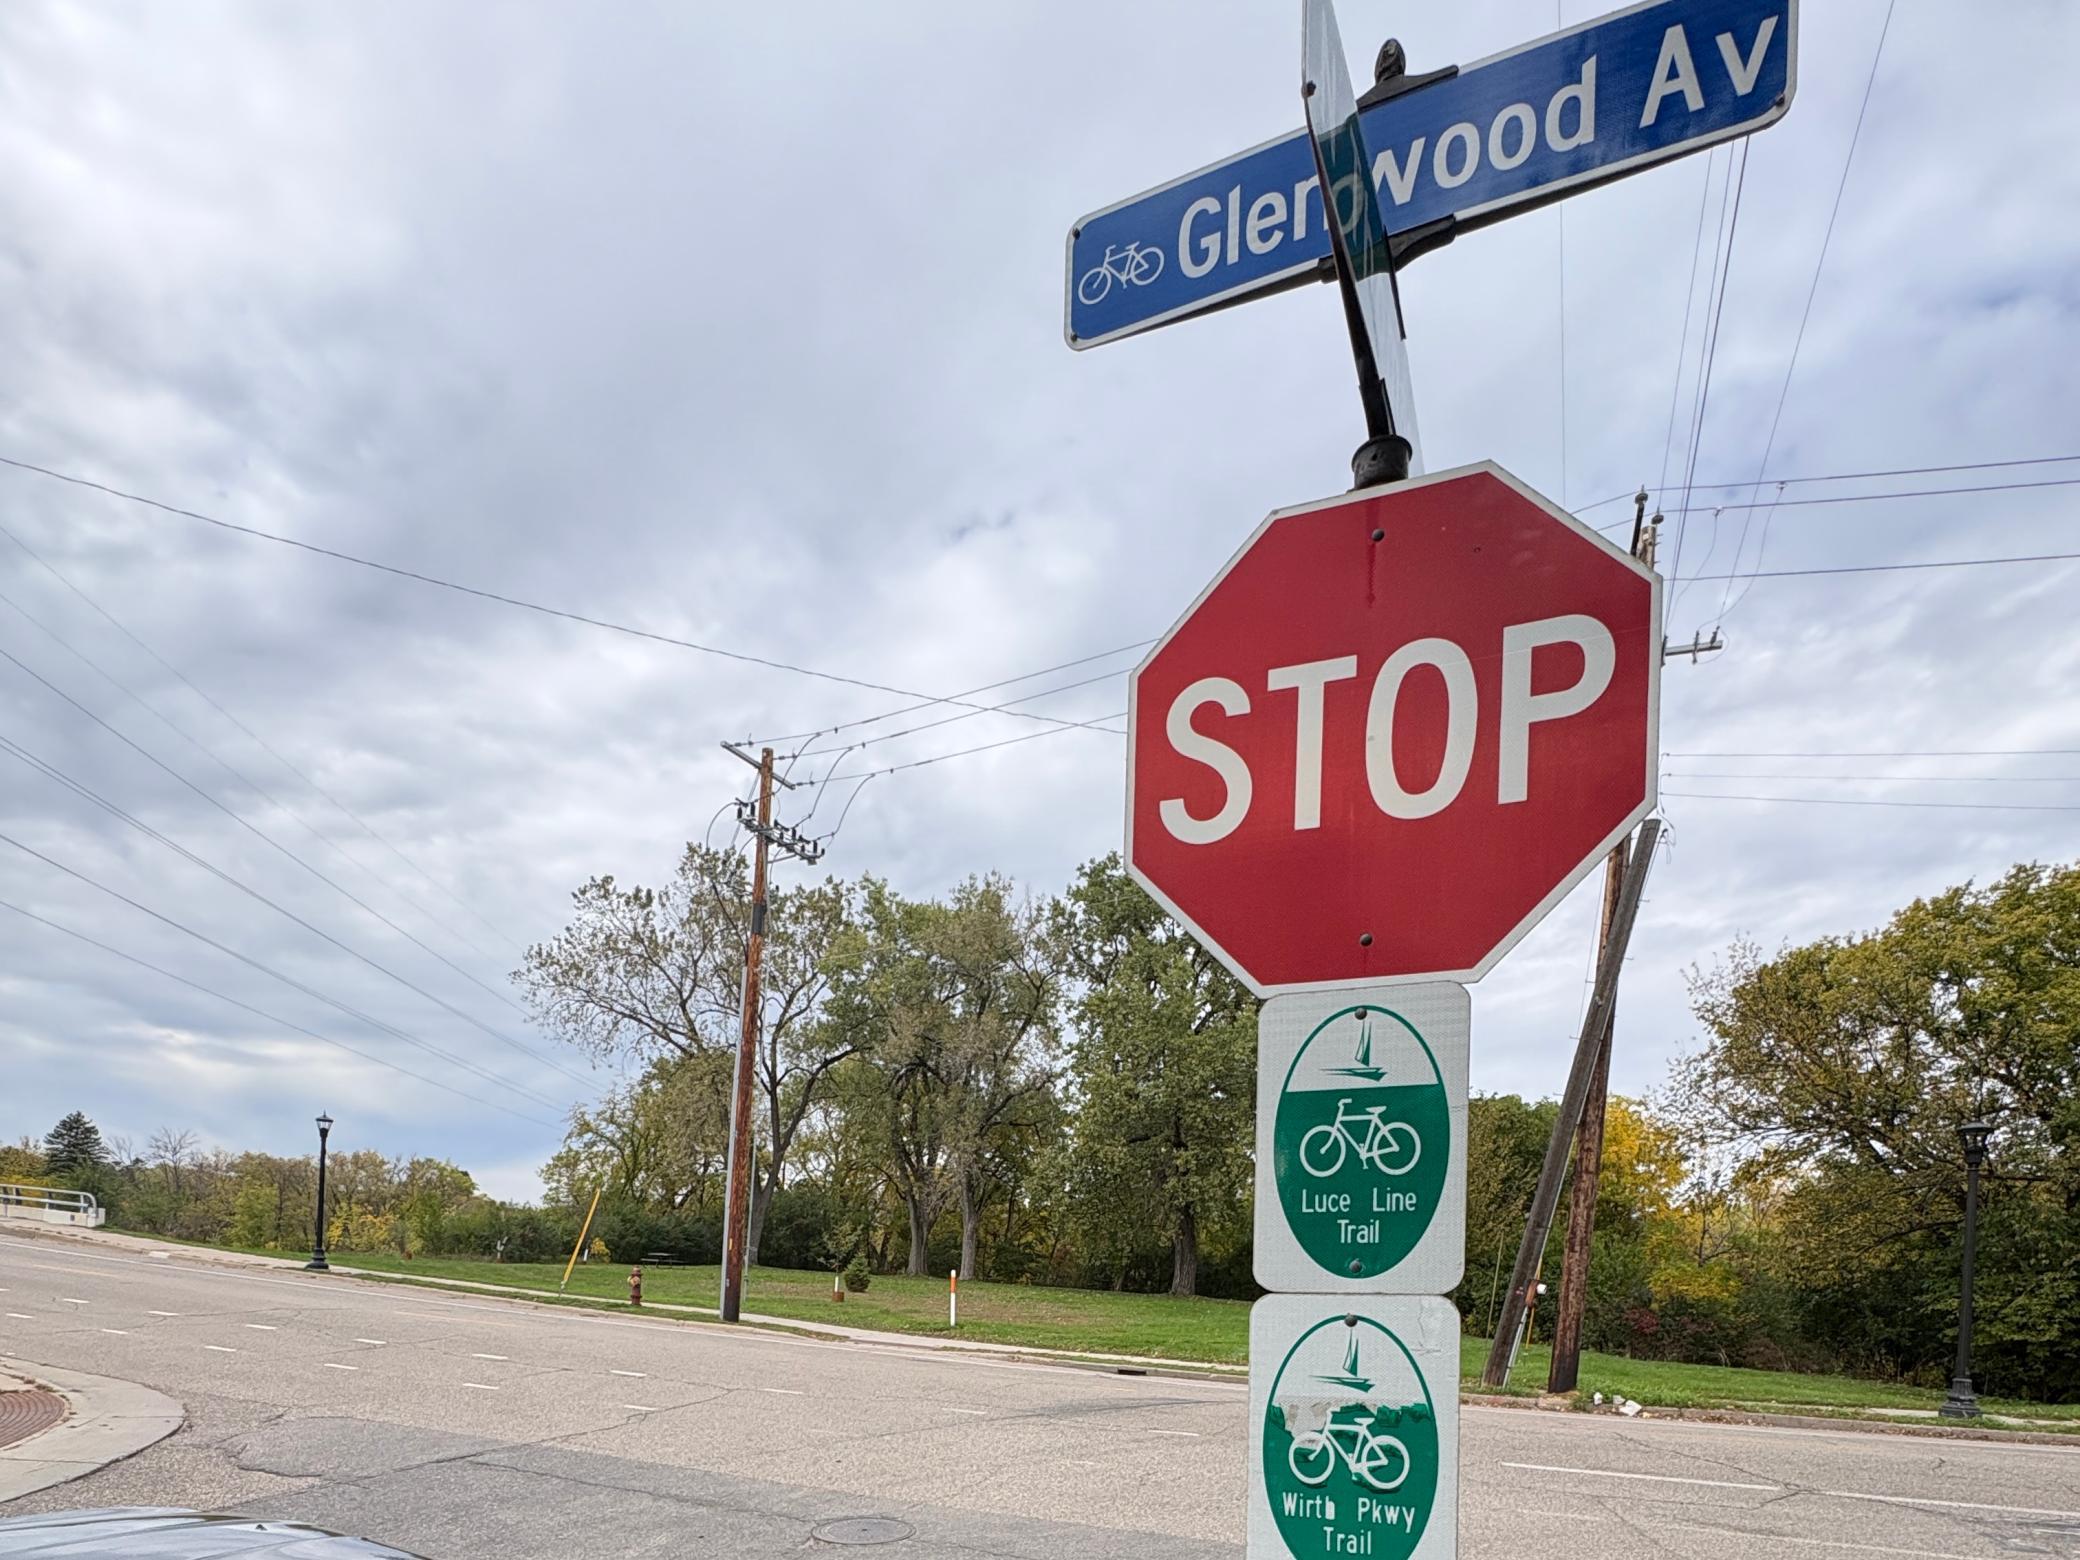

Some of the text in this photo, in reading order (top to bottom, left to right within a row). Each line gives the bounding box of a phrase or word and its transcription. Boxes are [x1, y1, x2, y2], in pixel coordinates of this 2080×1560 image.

[1639, 15, 1779, 128] Av
[1159, 614, 1616, 845] STOP
[1301, 1187, 1417, 1213] Luce Line
[1337, 1219, 1380, 1244] Trail
[1282, 1491, 1415, 1533] Wirth Pkwy
[1323, 1526, 1372, 1555] Trail
